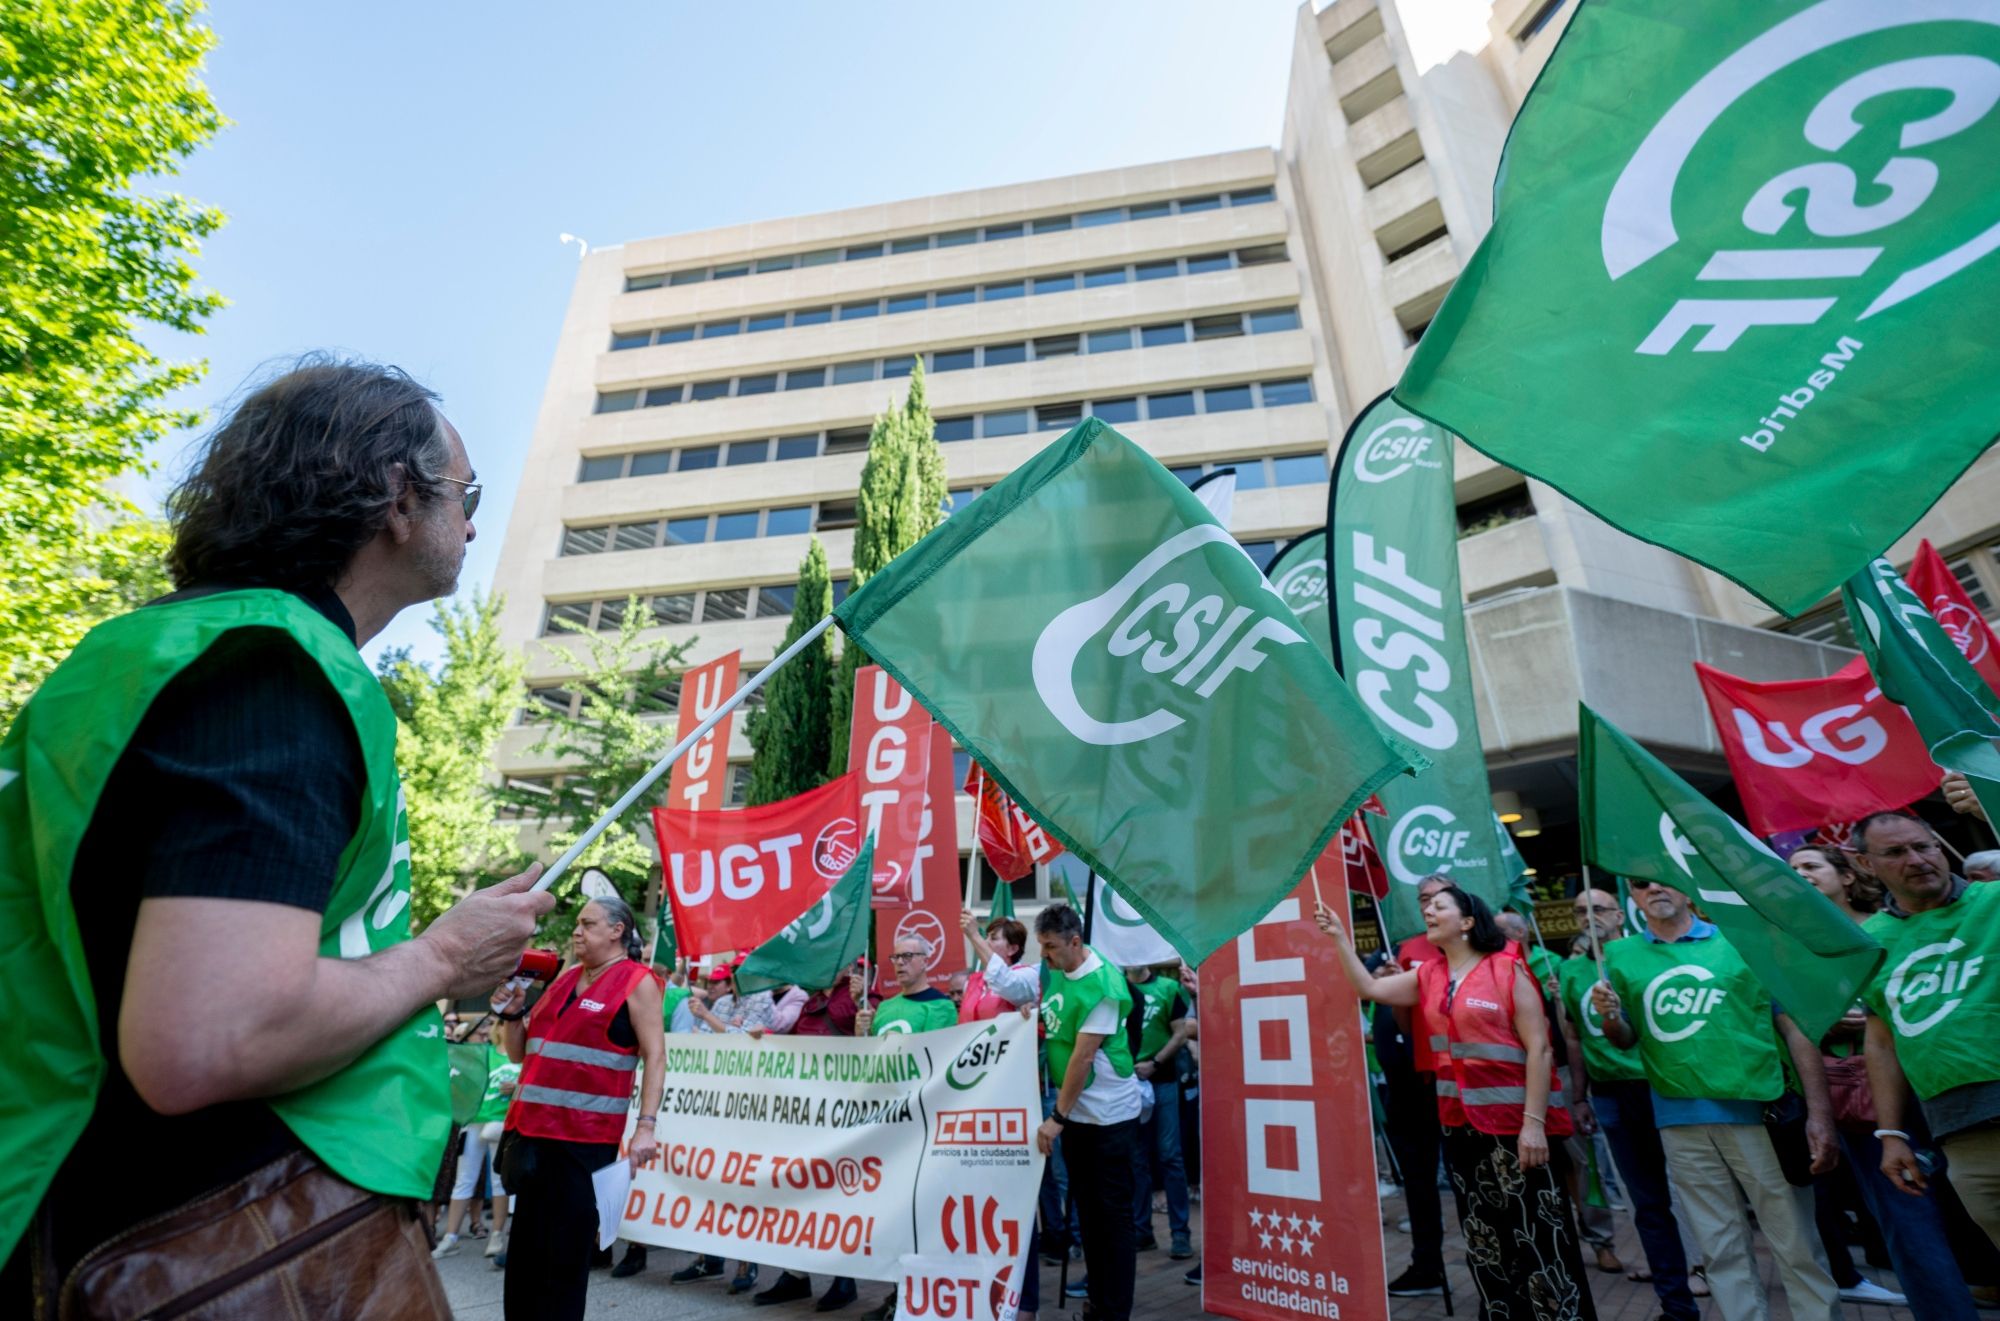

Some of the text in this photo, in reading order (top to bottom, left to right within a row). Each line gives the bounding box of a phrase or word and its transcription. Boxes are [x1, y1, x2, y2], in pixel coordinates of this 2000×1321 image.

[1368, 434, 1432, 463] CSIF
[1287, 574, 1329, 599] CSI
[1107, 582, 1308, 699] CSIF
[1352, 530, 1459, 750] CSIF
[1733, 688, 1888, 769] UG
[861, 669, 913, 849] UGT
[1403, 827, 1471, 858] CSIF
[669, 833, 803, 907] UGT
[1656, 987, 1727, 1016] CSIF
[667, 1047, 709, 1075] SOCIAL
[713, 1049, 753, 1077] DIGNA
[756, 1050, 795, 1079] PARA
[799, 1052, 819, 1080] LA
[674, 1088, 721, 1117] SOCIAL
[724, 1091, 768, 1121] DIGNA
[771, 1094, 811, 1127] PARA
[815, 1097, 827, 1128] A
[935, 1109, 1027, 1144] CCOO
[721, 1151, 763, 1188] DE
[770, 1156, 883, 1196] TOD@S
[651, 1193, 691, 1229] LO
[694, 1199, 875, 1256] ACORDADO!
[1231, 1256, 1349, 1295] servicios a la
[905, 1275, 981, 1321] UGT
[1241, 1281, 1340, 1321] ciudadanía
